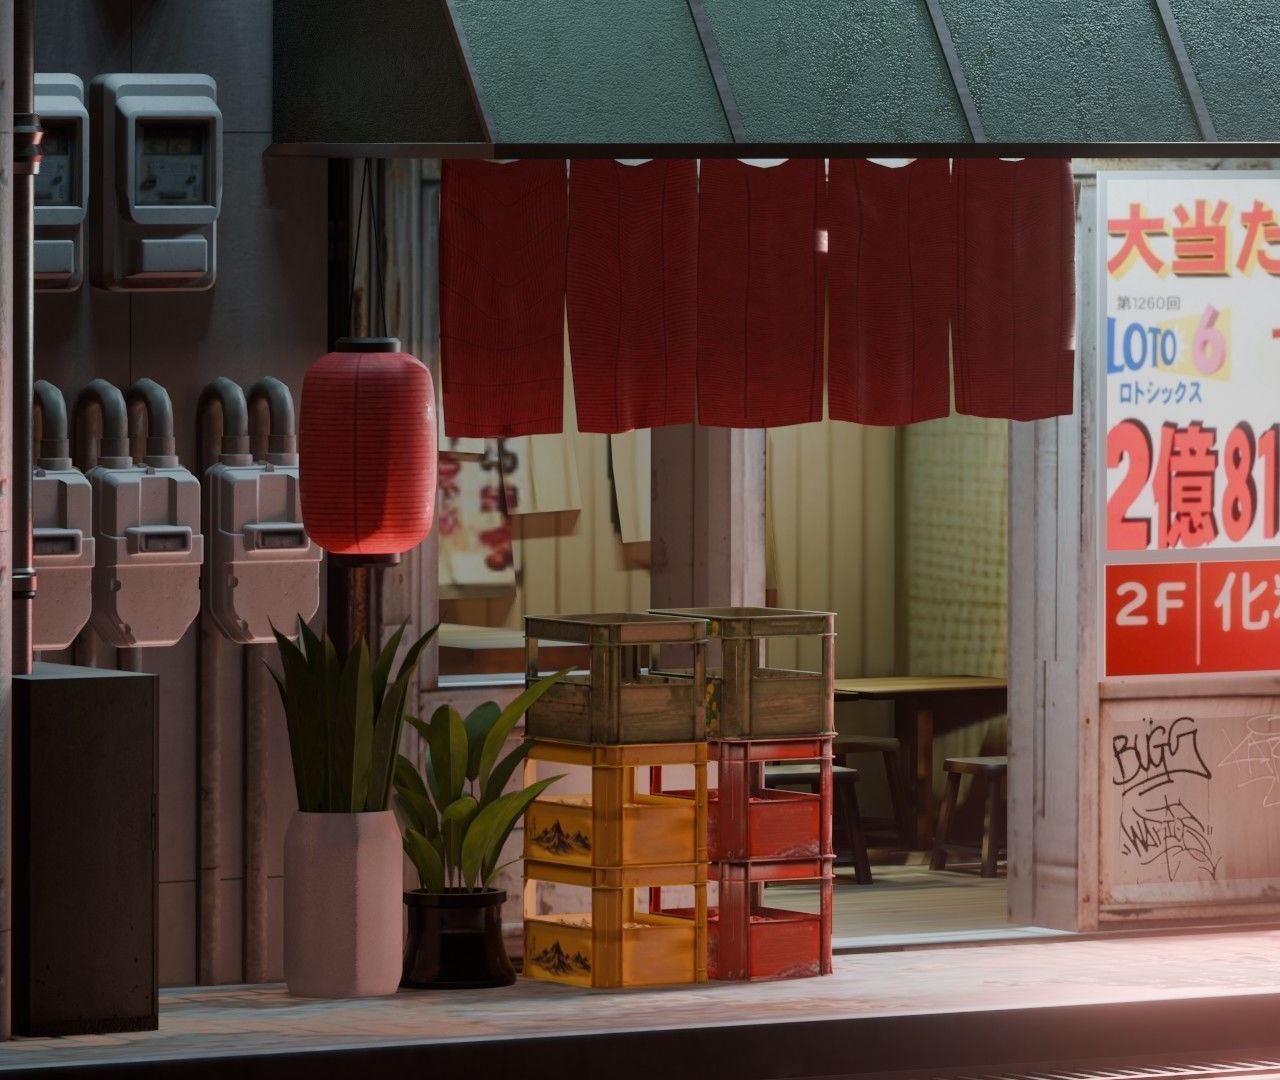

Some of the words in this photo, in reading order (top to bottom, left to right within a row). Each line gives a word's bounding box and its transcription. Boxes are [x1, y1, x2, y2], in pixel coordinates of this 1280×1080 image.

[1117, 295, 1181, 311] 第1260回
[1107, 316, 1177, 374] LOTO
[1119, 380, 1203, 404] ロトシックス
[1115, 581, 1187, 627] 2F
